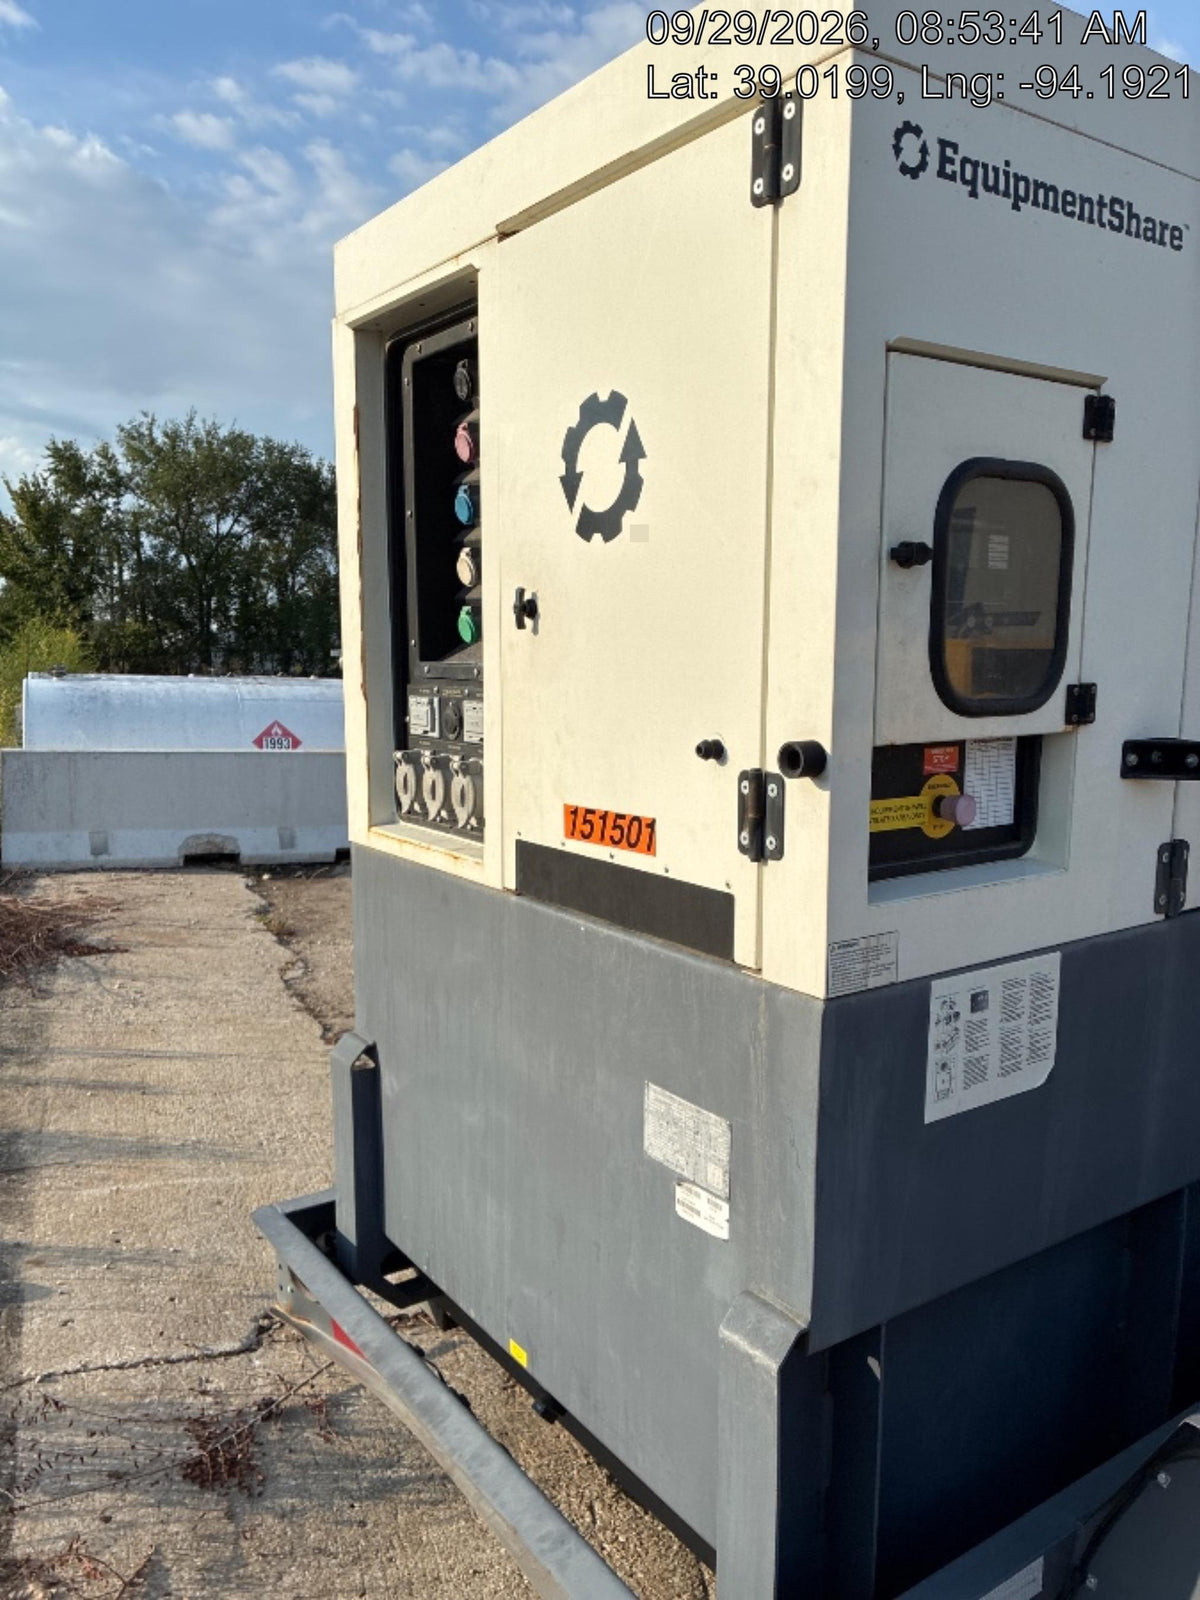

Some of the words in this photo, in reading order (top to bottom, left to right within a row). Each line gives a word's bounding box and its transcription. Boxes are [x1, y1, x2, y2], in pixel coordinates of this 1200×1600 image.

[937, 137, 1184, 251] EquipmentShare
[264, 737, 291, 750] 1993
[570, 806, 657, 852] 151501
